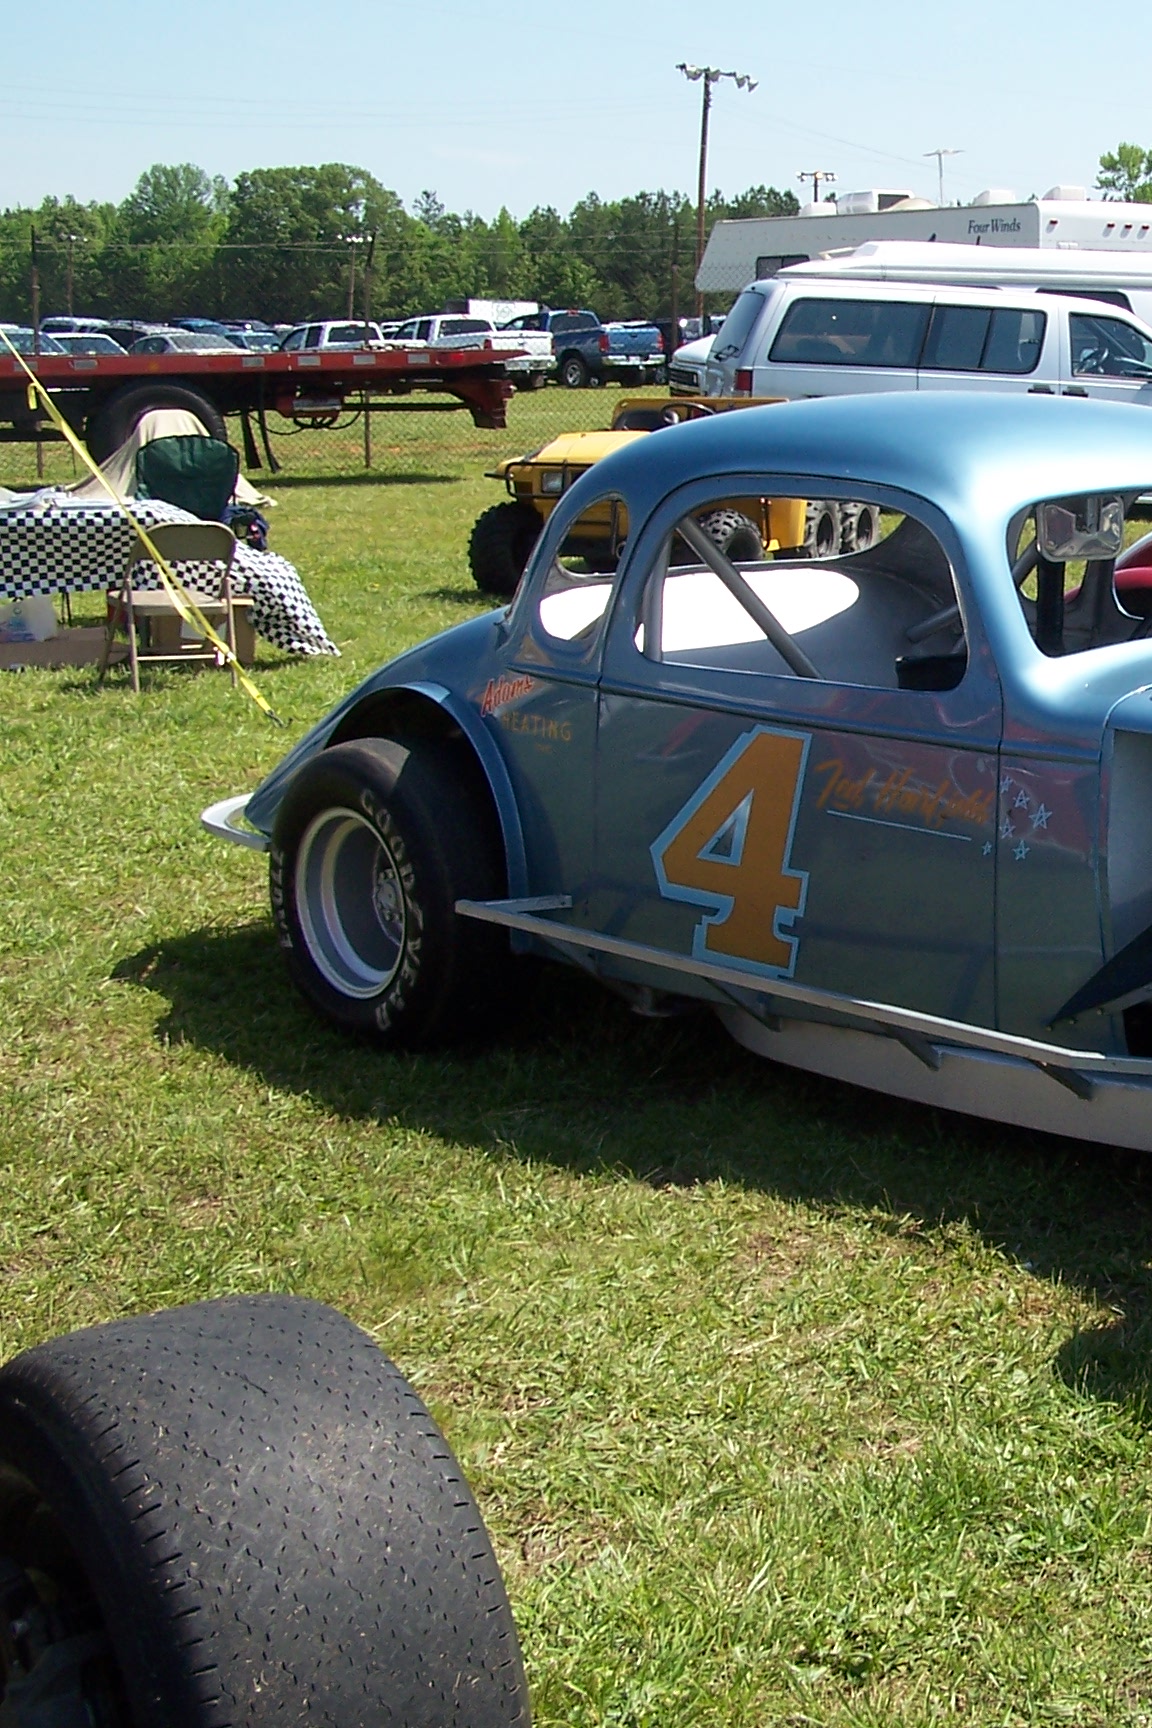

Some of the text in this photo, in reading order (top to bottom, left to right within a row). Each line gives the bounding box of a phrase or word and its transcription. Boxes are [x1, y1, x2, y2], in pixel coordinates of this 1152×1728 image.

[967, 217, 1022, 235] Four Winds
[481, 674, 535, 717] Adams
[502, 711, 574, 743] HEATING
[814, 758, 876, 811] Ted
[650, 724, 813, 979] 4
